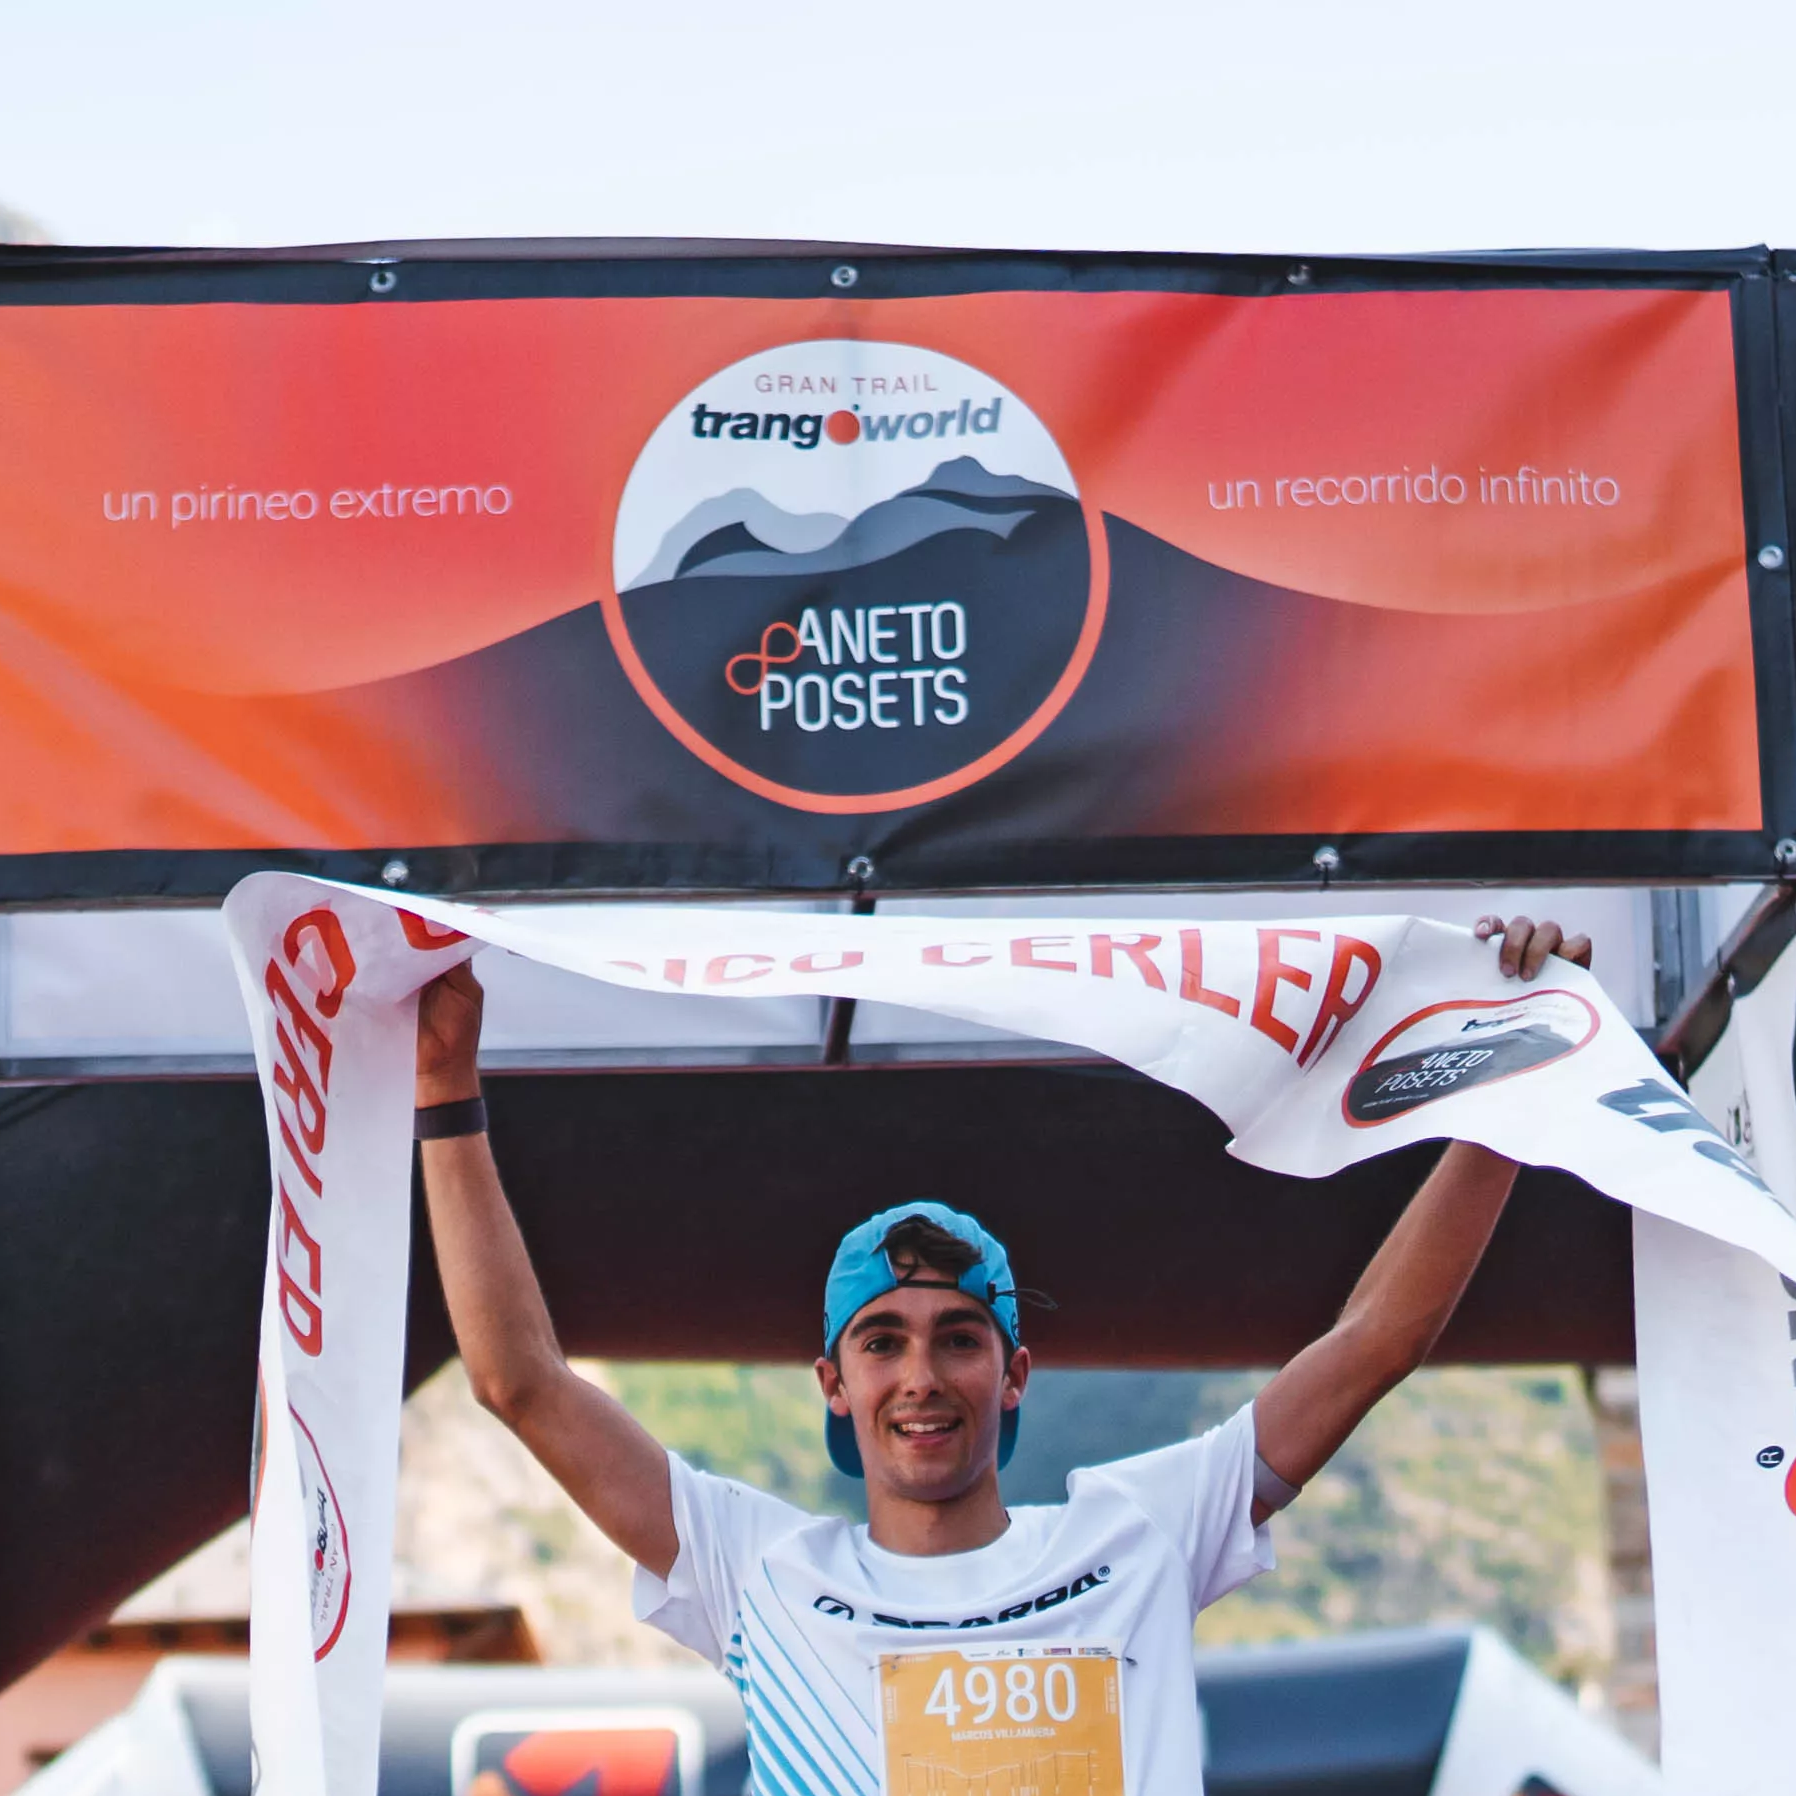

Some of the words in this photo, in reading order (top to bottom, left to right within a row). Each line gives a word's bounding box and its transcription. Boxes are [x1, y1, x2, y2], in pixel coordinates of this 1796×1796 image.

[755, 375, 837, 394] GRAN
[852, 374, 938, 395] TRAIL
[103, 490, 157, 521] un
[172, 486, 318, 528] pirineo
[330, 481, 512, 517] extremo
[1208, 480, 1260, 511] un
[1275, 465, 1467, 508] recorrido
[1480, 466, 1620, 506] infinito
[800, 601, 967, 665] ANETO
[760, 668, 969, 731] POSETS
[922, 928, 1381, 1076] CERLER
[1375, 1068, 1468, 1094] POSETS
[1421, 1050, 1493, 1070] ANETO
[924, 1662, 1077, 1726] 4980
[951, 1728, 994, 1742] MARCOS
